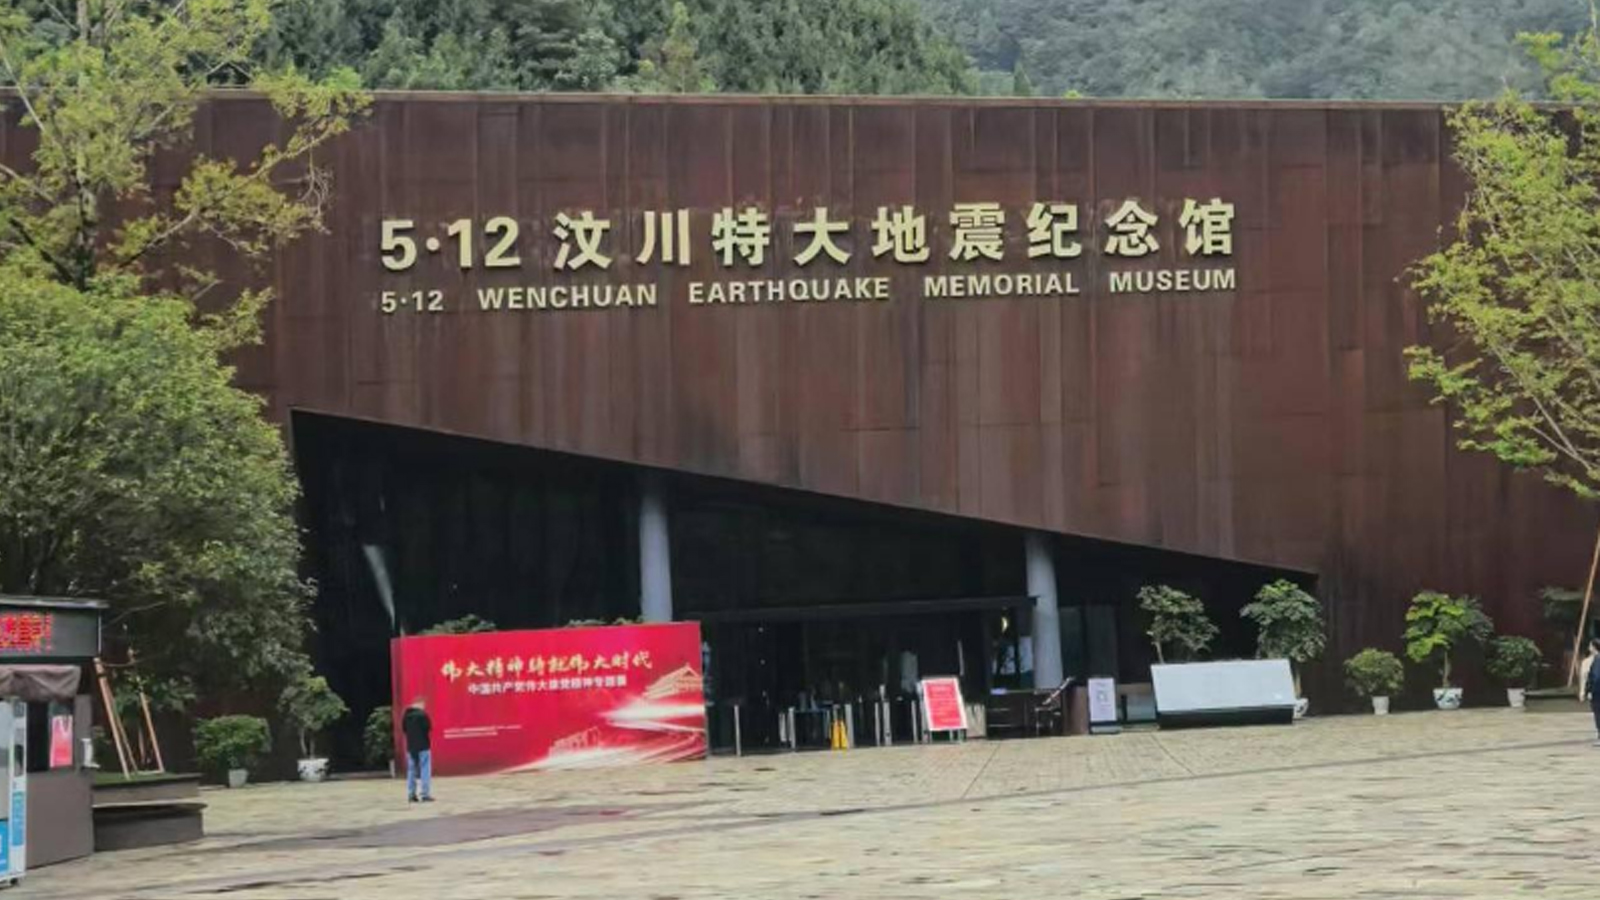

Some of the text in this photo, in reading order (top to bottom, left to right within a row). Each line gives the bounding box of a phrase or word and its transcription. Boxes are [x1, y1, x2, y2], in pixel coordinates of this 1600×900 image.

[478, 284, 657, 310] WENCHUAN
[689, 275, 890, 304] EARTHQUAKE
[924, 272, 1080, 297] MEMORIAL
[1109, 268, 1237, 293] MUSEUM
